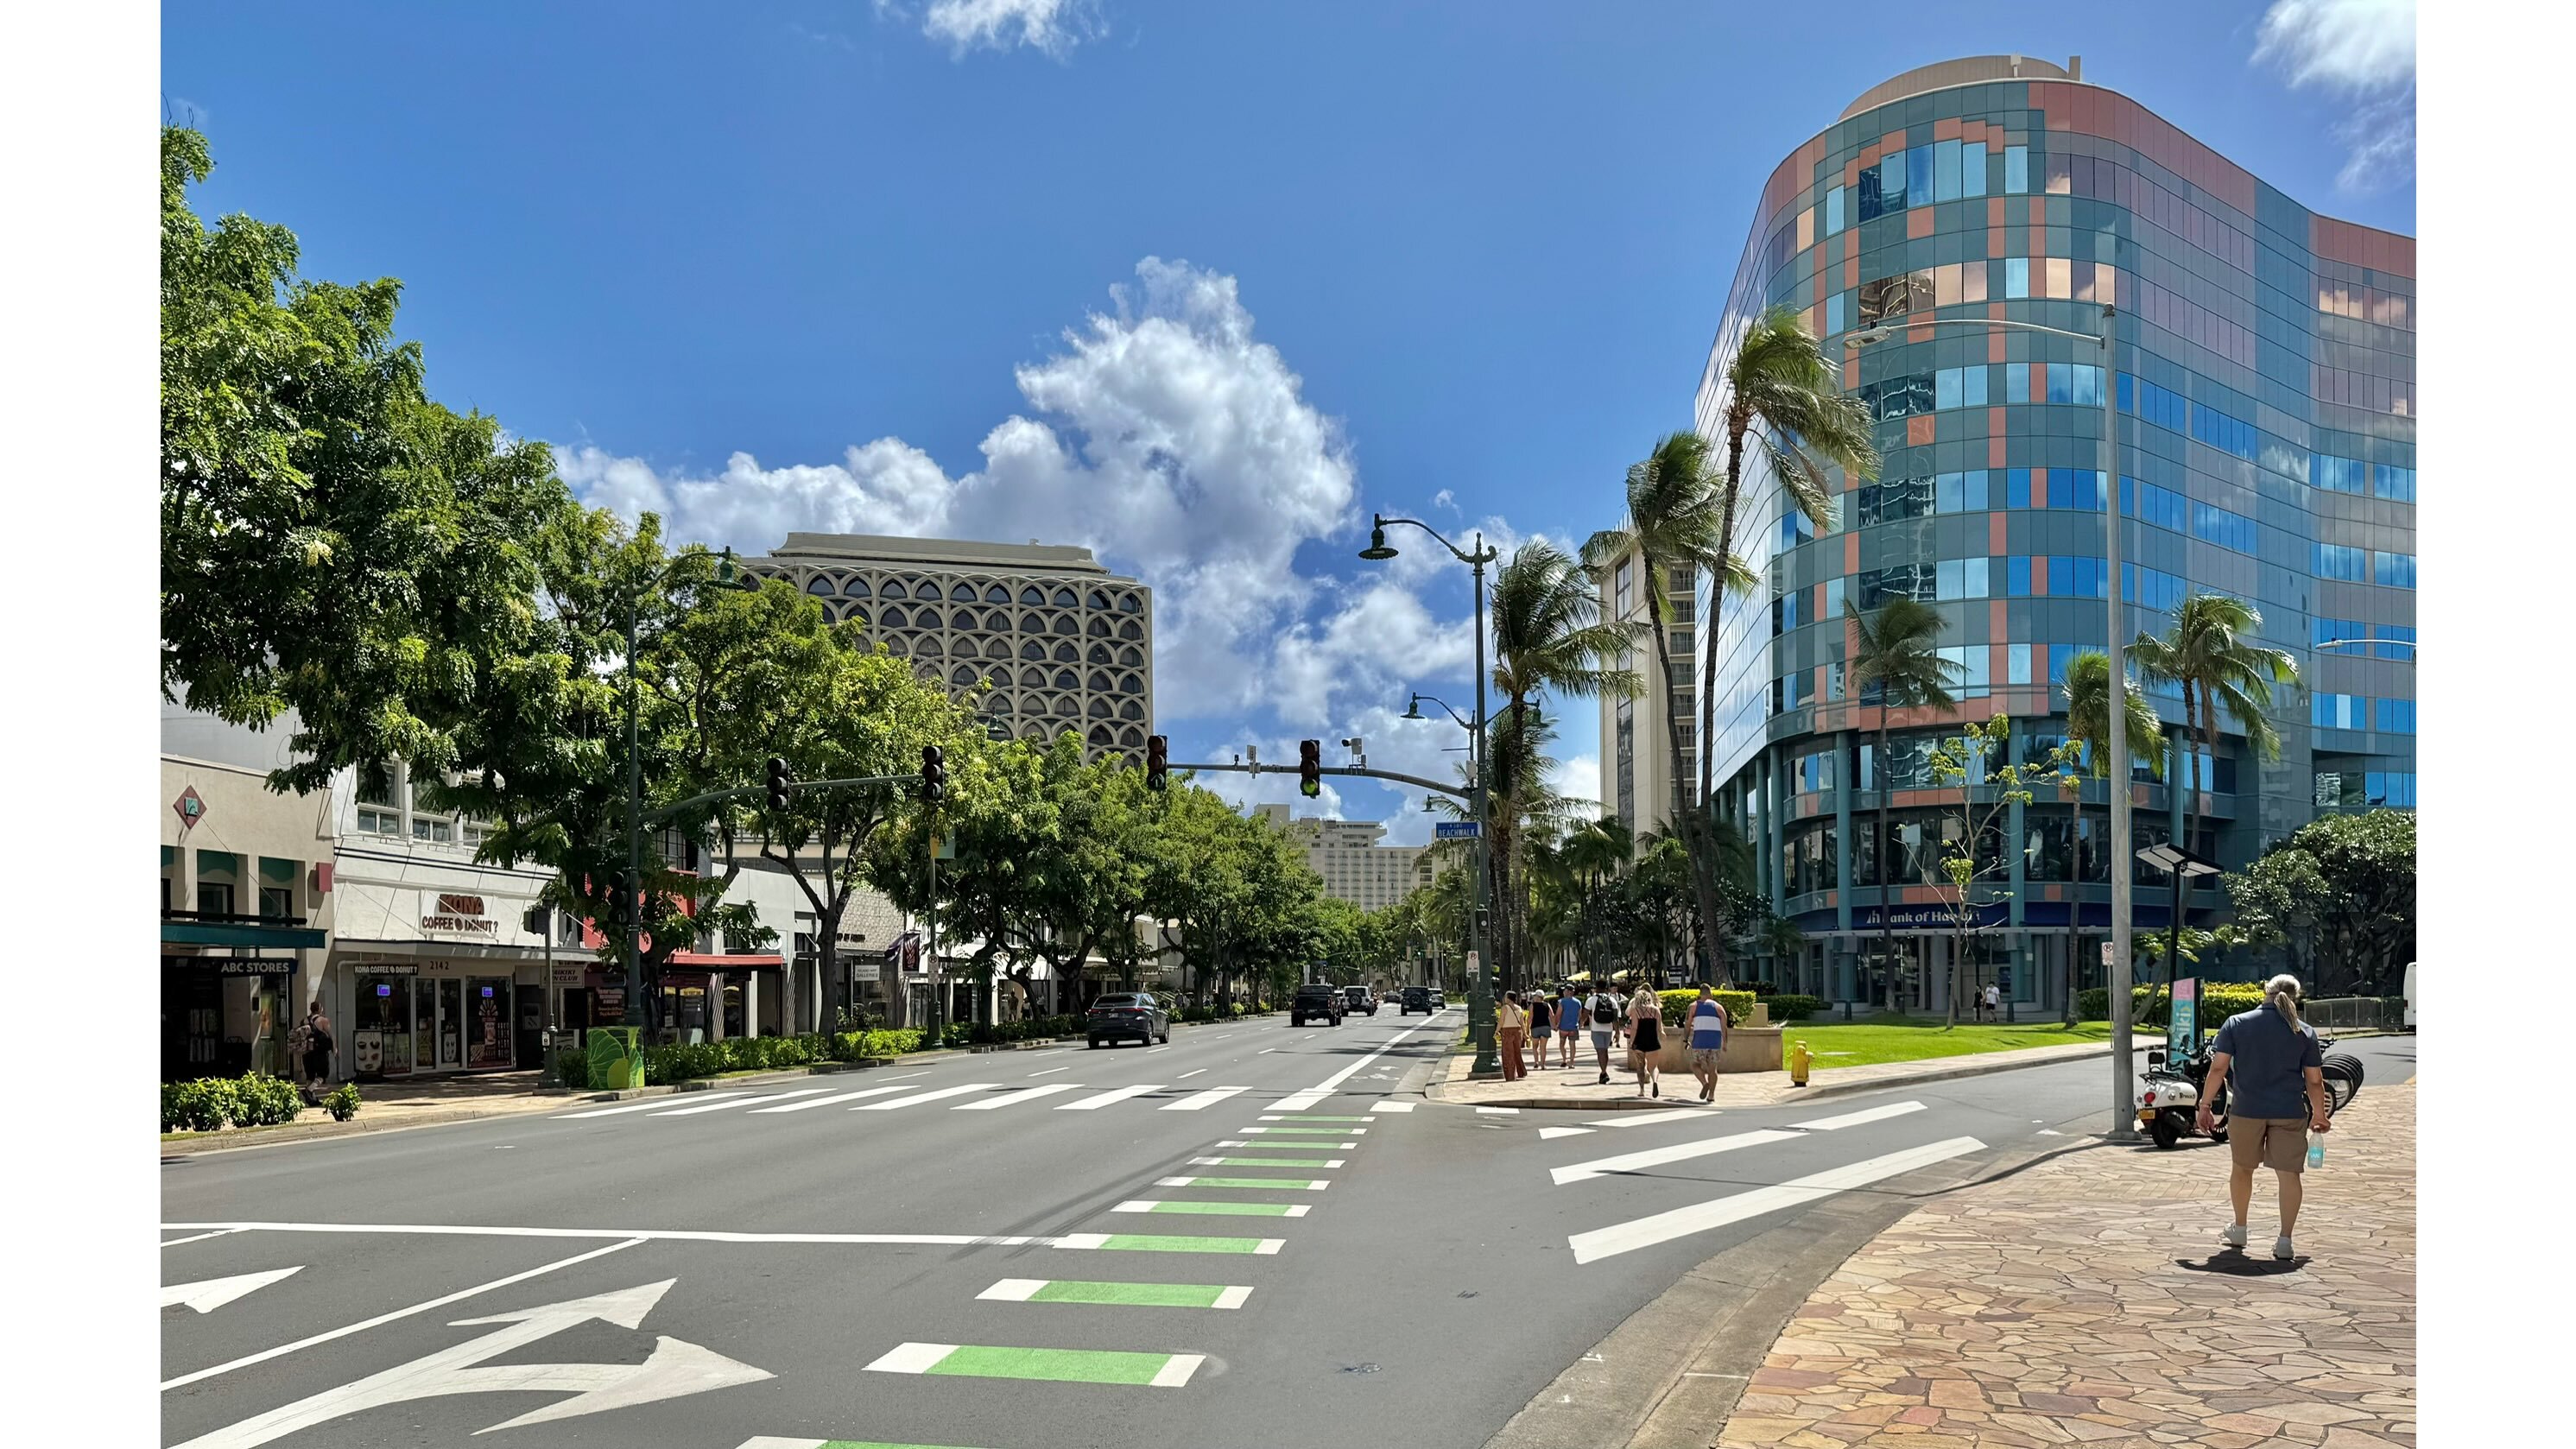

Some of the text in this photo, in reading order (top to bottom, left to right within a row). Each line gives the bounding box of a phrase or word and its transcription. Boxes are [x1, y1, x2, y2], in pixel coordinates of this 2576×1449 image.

[440, 894, 484, 915] KONA
[1915, 912, 1930, 922] of
[422, 916, 454, 930] COFFEE
[221, 962, 289, 972] ABC STORES
[370, 965, 389, 974] COFFEE
[430, 961, 449, 970] 2142
